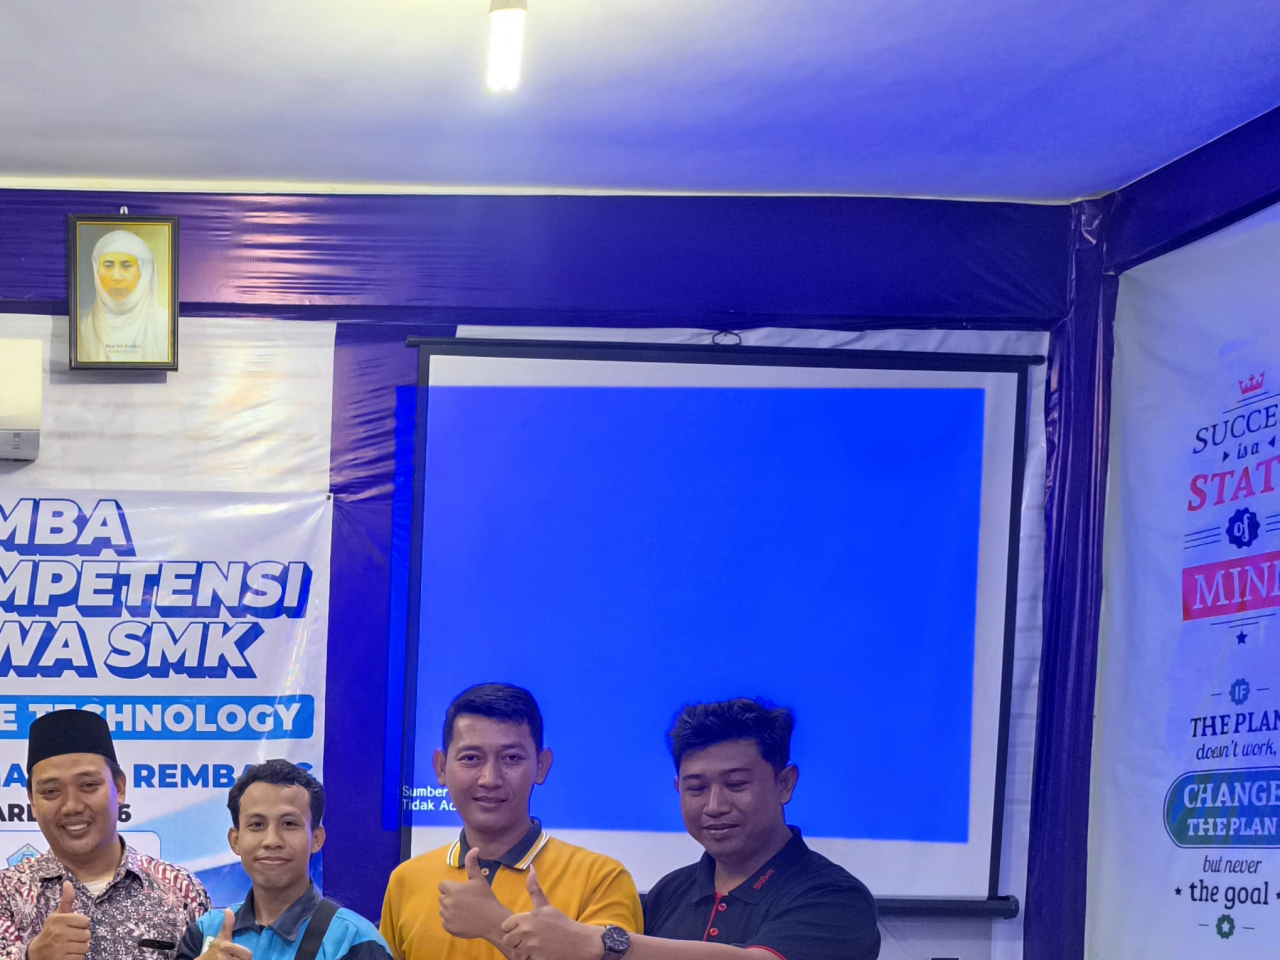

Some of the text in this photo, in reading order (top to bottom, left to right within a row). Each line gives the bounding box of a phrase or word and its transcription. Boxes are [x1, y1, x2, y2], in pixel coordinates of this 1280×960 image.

[1192, 403, 1280, 454] SUCCE
[1237, 441, 1260, 459] is a
[1187, 455, 1280, 511] STAT
[1233, 513, 1250, 542] of
[104, 620, 265, 680] SMK
[1235, 685, 1247, 700] IF
[1190, 714, 1231, 738] THE
[1196, 738, 1277, 760] doesn't work,
[402, 785, 448, 797] Sumber
[402, 798, 435, 811] Tidak
[1187, 816, 1277, 836] THE PLAN
[1203, 855, 1262, 874] but never
[1189, 878, 1269, 909] the goal
